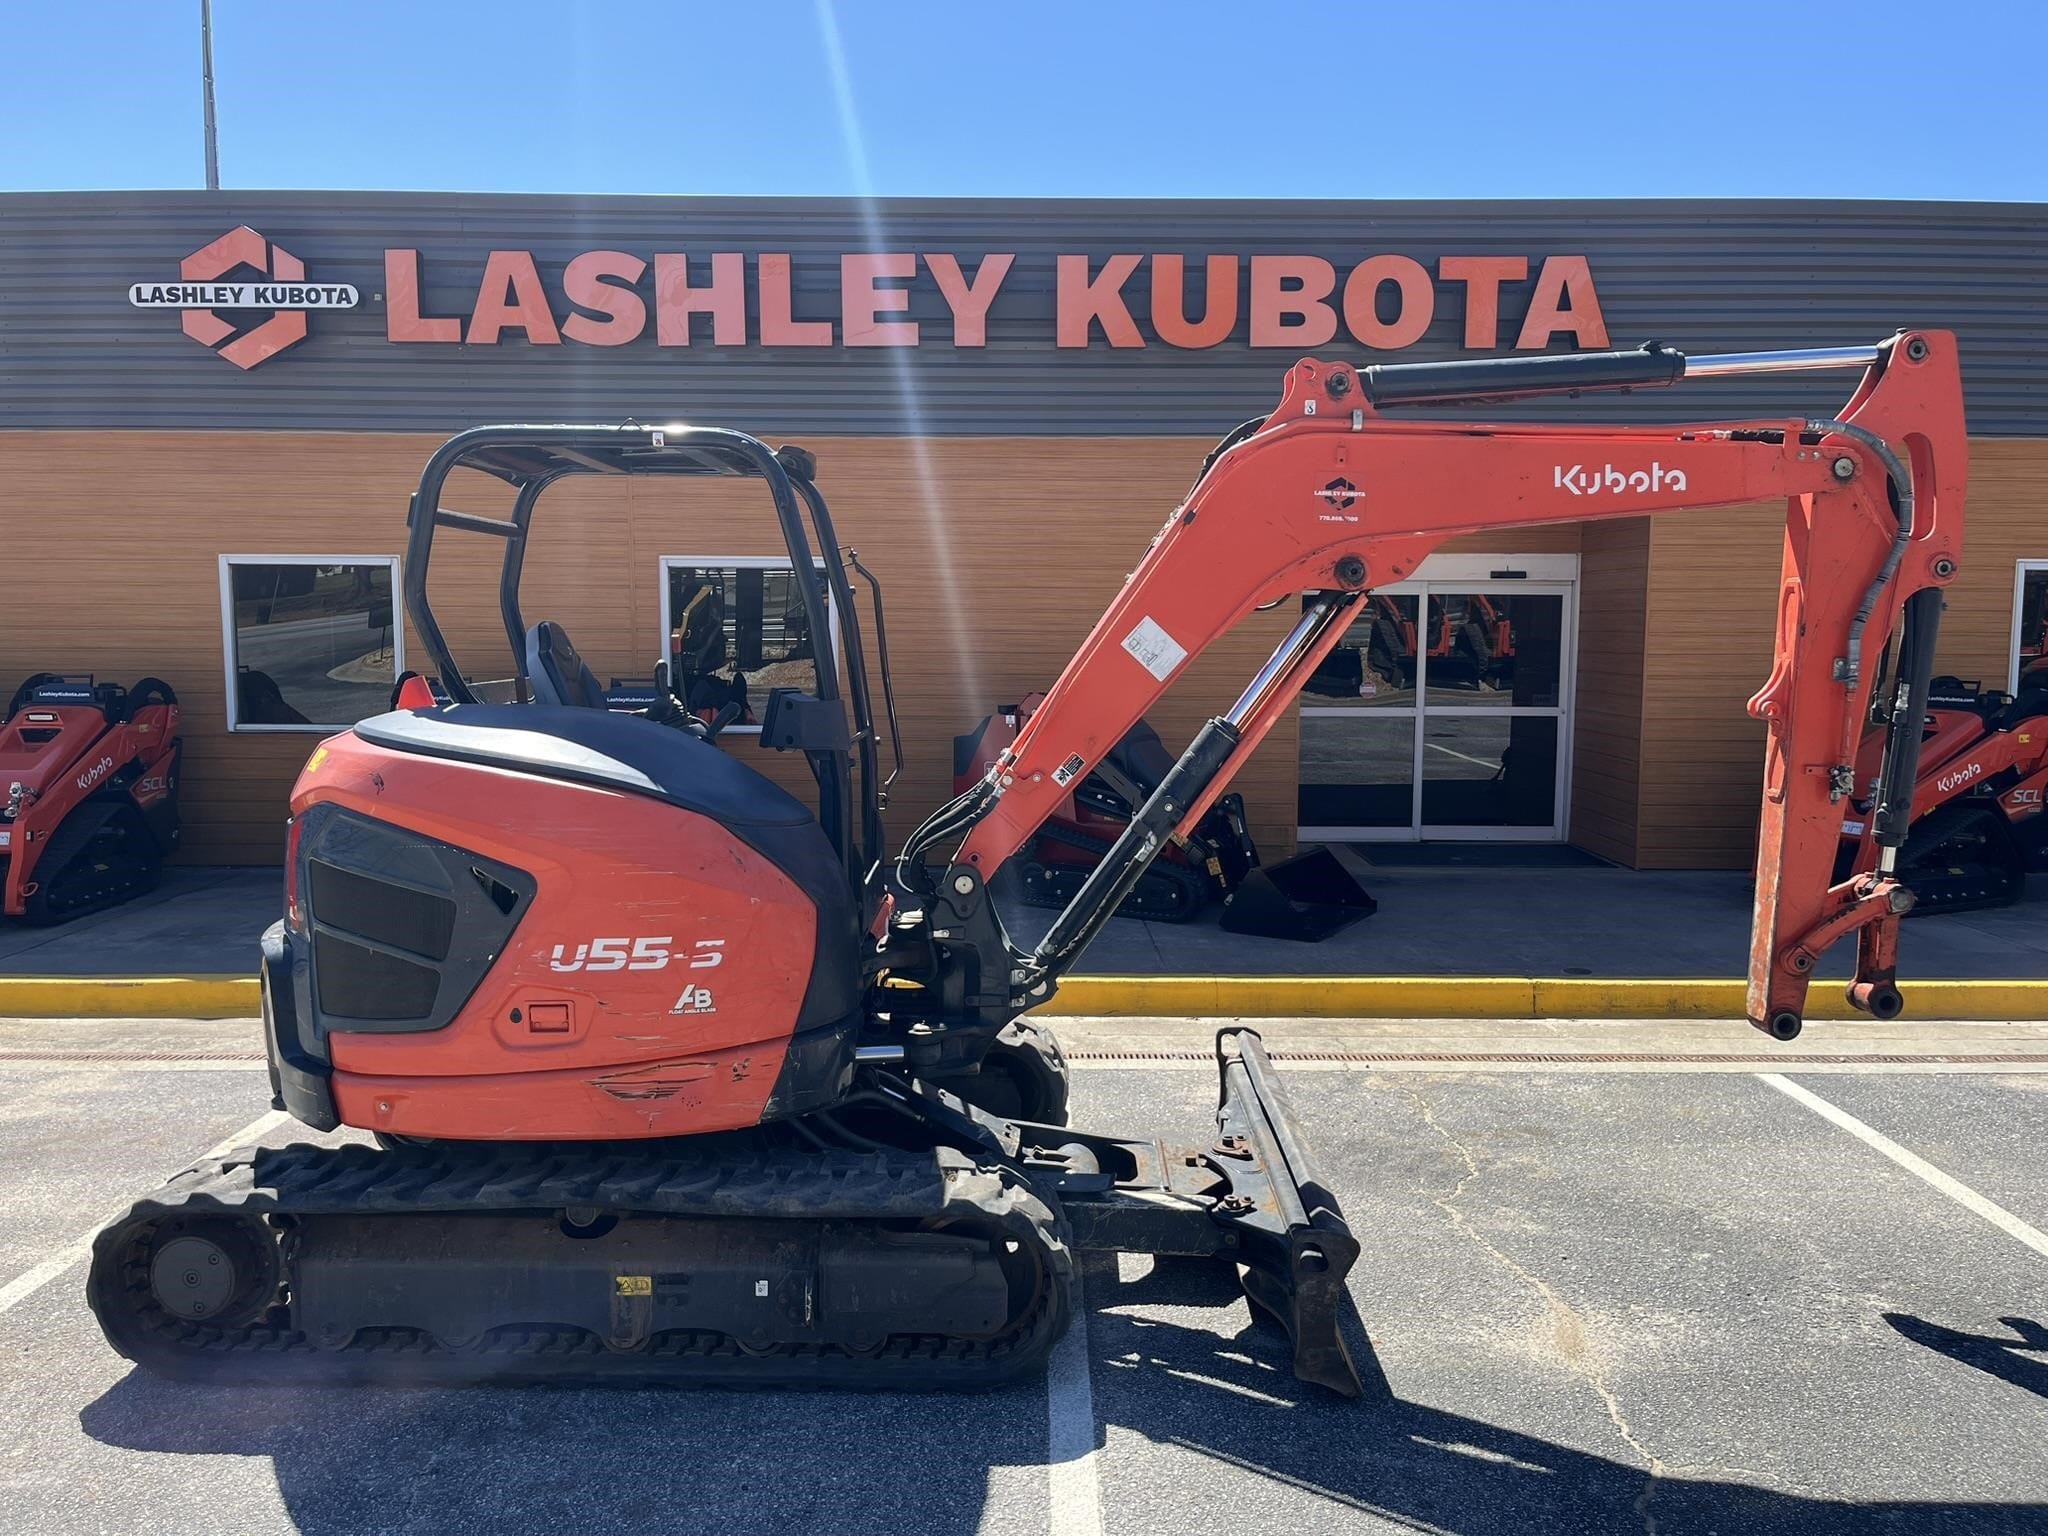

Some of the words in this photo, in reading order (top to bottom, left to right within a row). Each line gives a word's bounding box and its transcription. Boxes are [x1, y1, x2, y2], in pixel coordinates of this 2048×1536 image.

[135, 286, 245, 304] LASHLEY
[254, 287, 353, 305] KUBOTA
[384, 249, 1016, 347] LASHLEY
[1056, 254, 1611, 350] KUBOTA
[1554, 462, 1687, 495] Kubota
[77, 756, 113, 789] Kubota
[142, 778, 167, 791] SCL
[1937, 763, 1981, 792] Kubota
[2011, 789, 2041, 803] SCL
